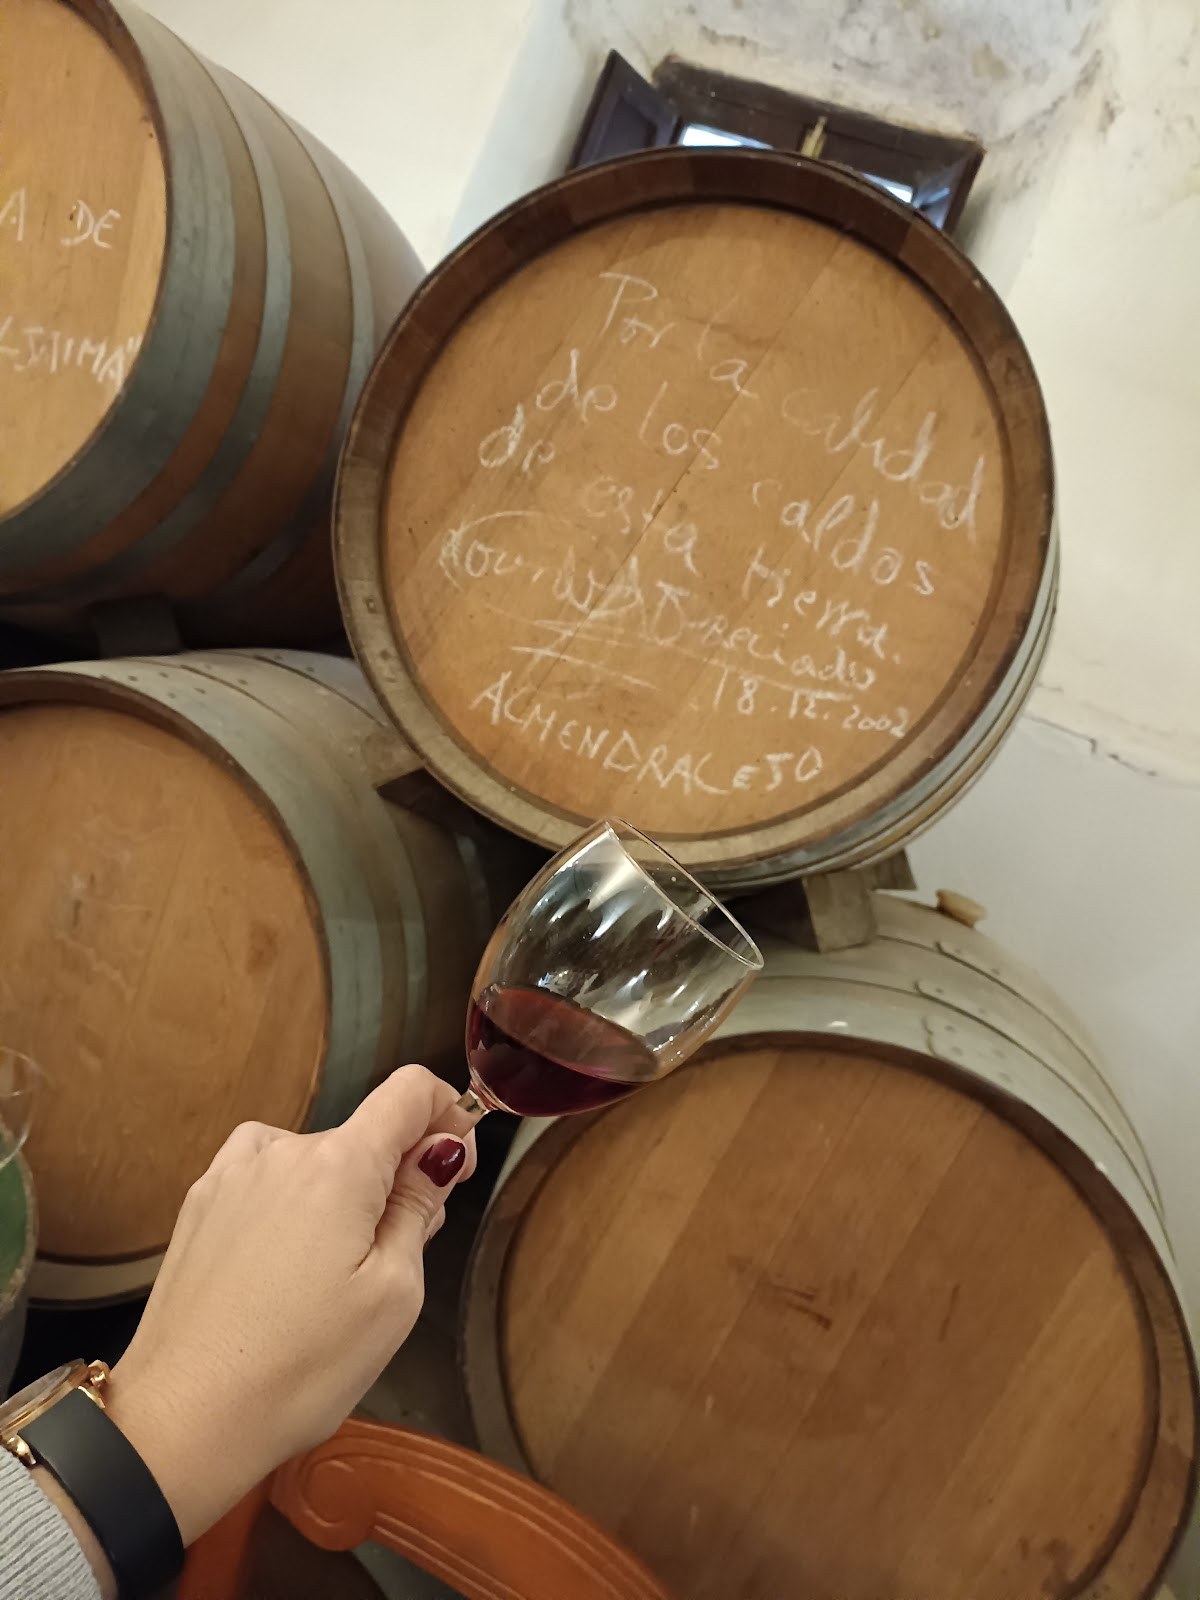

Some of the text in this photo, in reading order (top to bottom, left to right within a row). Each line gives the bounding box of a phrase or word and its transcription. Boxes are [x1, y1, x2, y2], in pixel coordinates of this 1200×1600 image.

[60, 199, 121, 249] DE
[598, 271, 677, 349] Por
[638, 380, 722, 471] los
